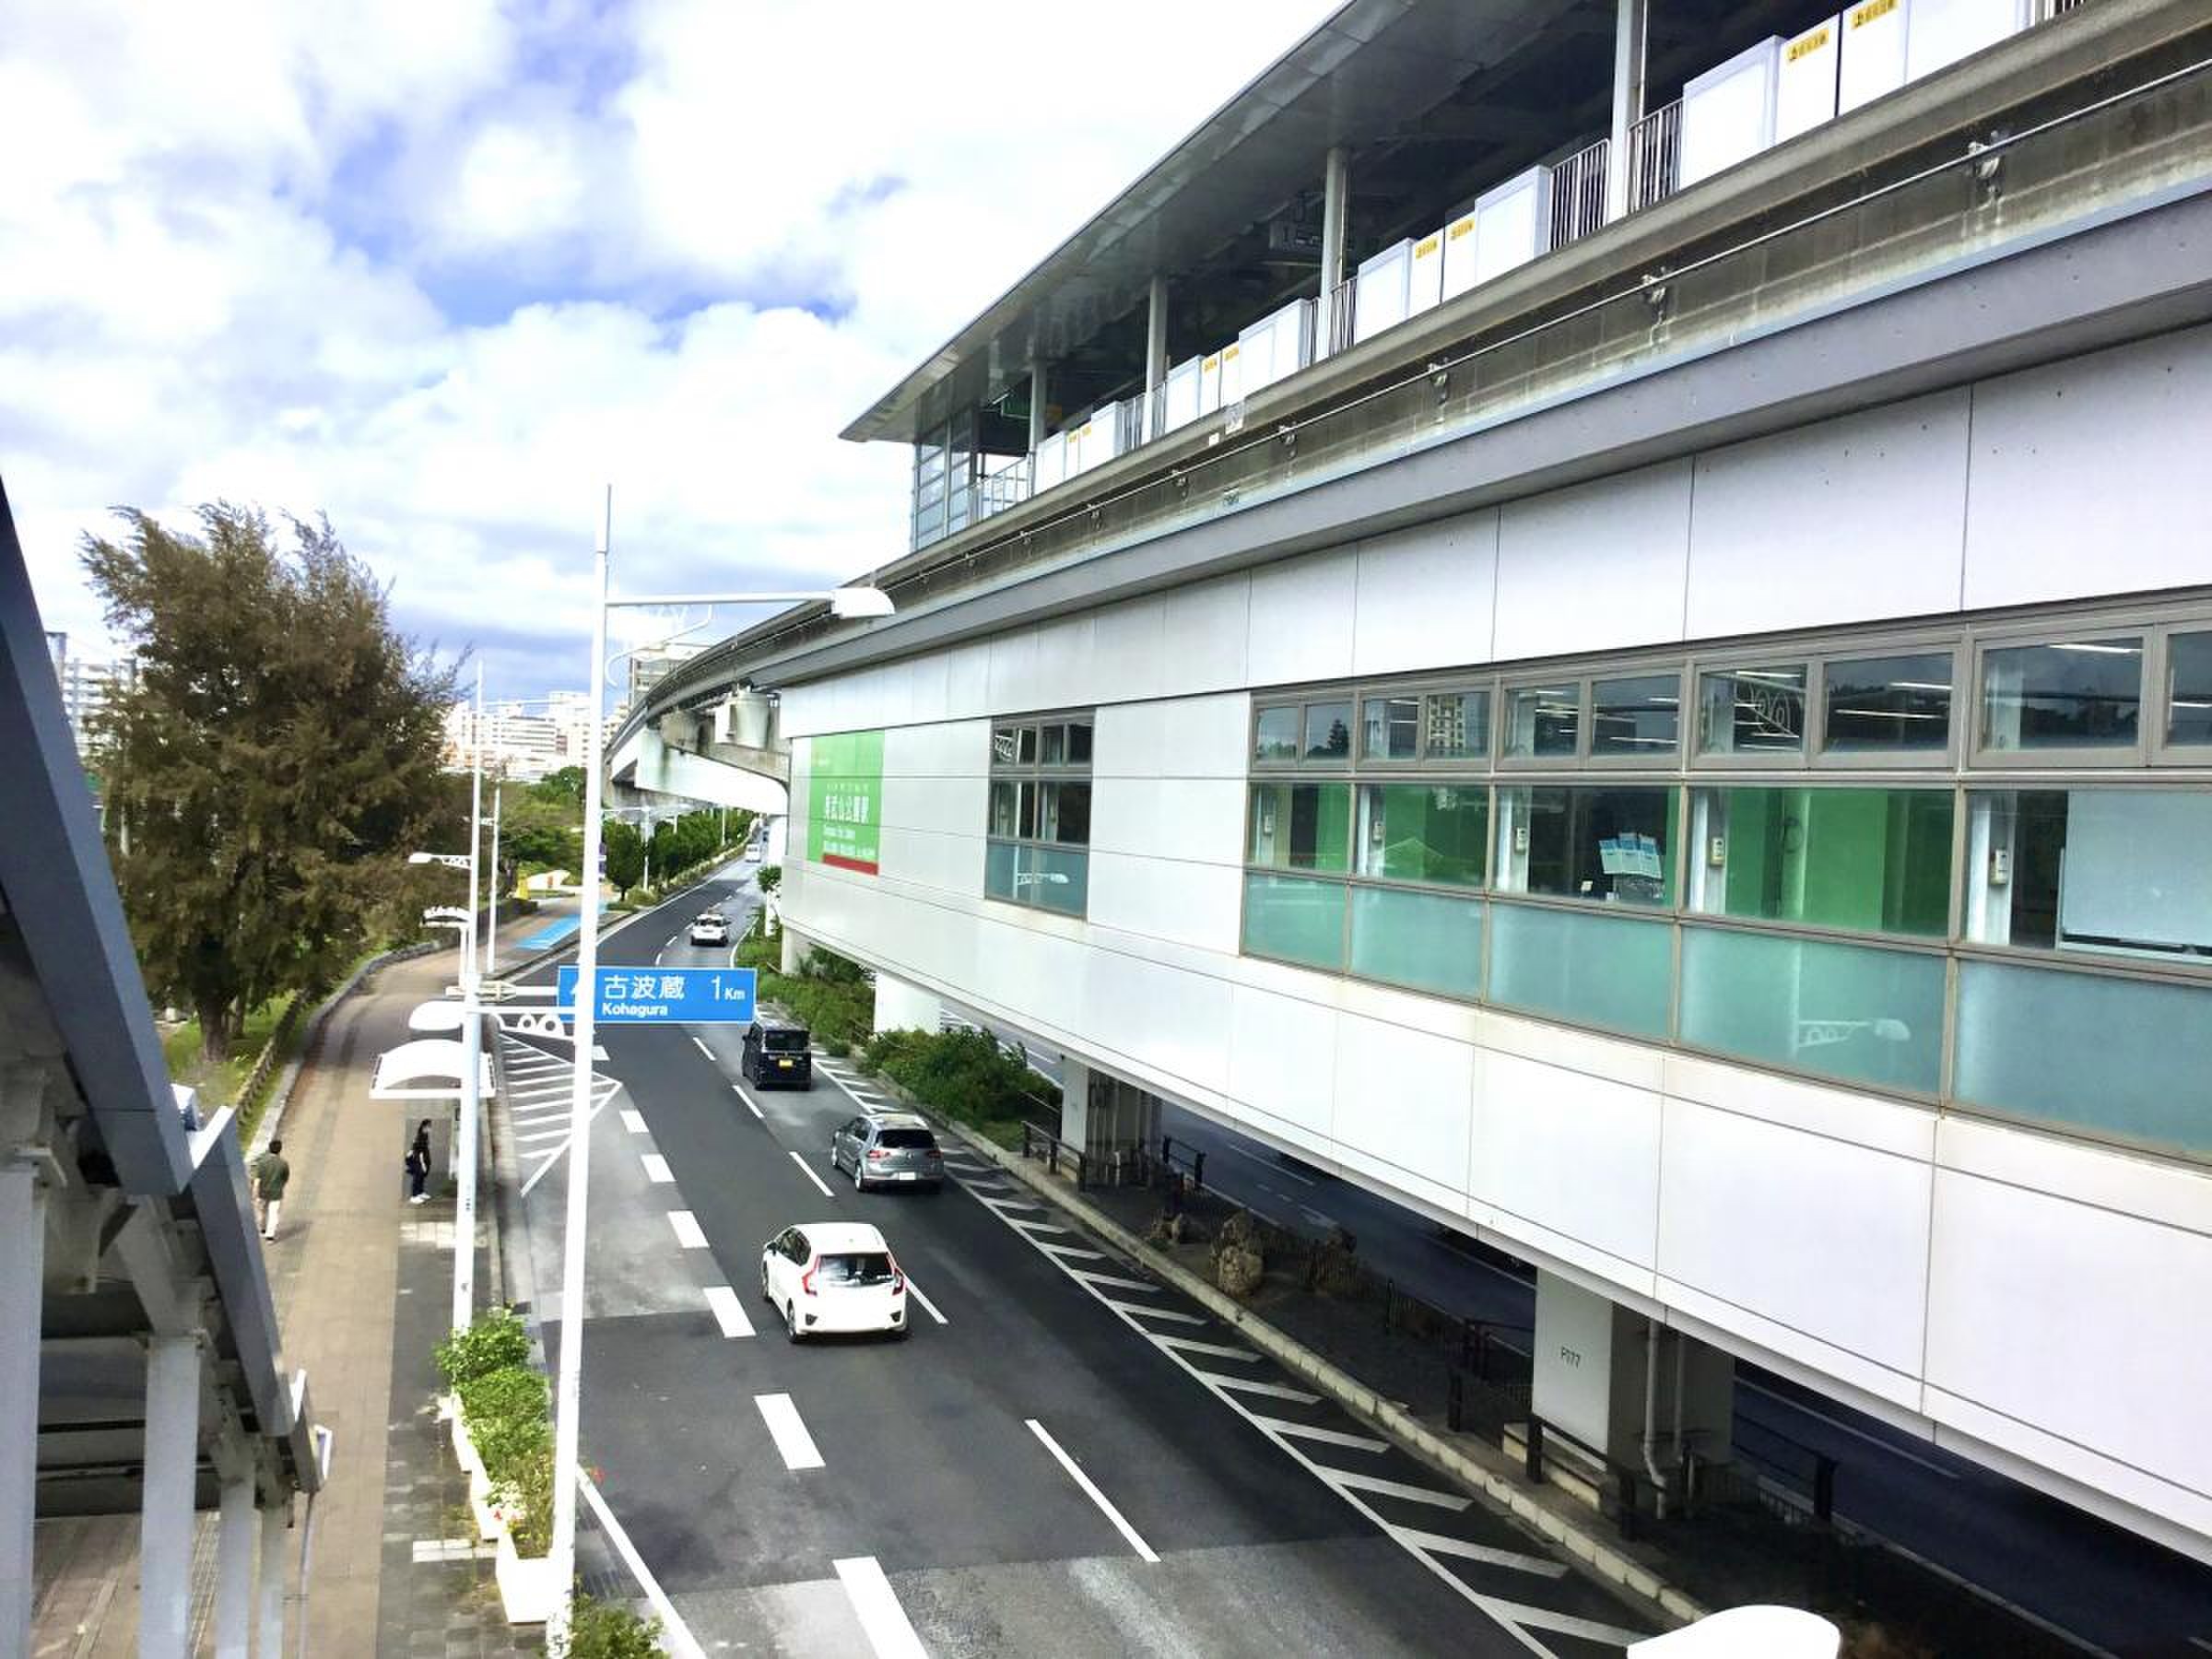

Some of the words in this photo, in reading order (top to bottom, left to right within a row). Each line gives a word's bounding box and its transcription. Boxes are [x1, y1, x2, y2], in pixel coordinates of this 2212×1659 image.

[604, 975, 687, 1001] 古波蔵
[602, 1003, 668, 1018] Kohagura
